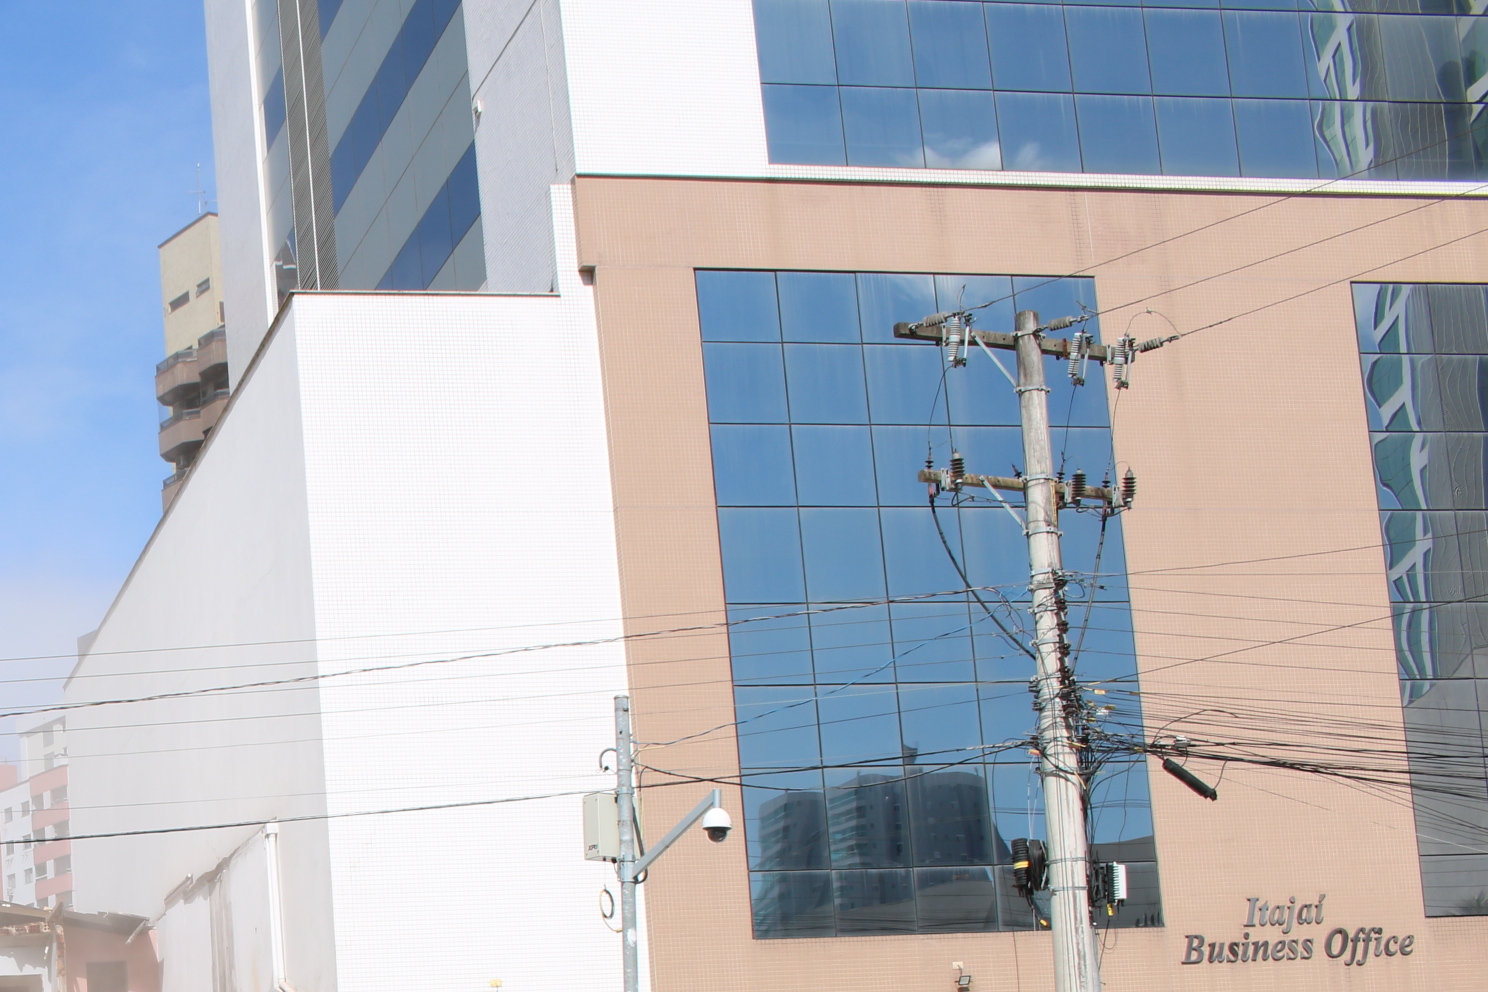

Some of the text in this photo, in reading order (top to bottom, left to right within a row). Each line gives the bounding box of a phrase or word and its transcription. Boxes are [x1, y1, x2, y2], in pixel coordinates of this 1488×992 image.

[1243, 893, 1326, 934] Itajaí
[1181, 927, 1415, 966] Business Office
